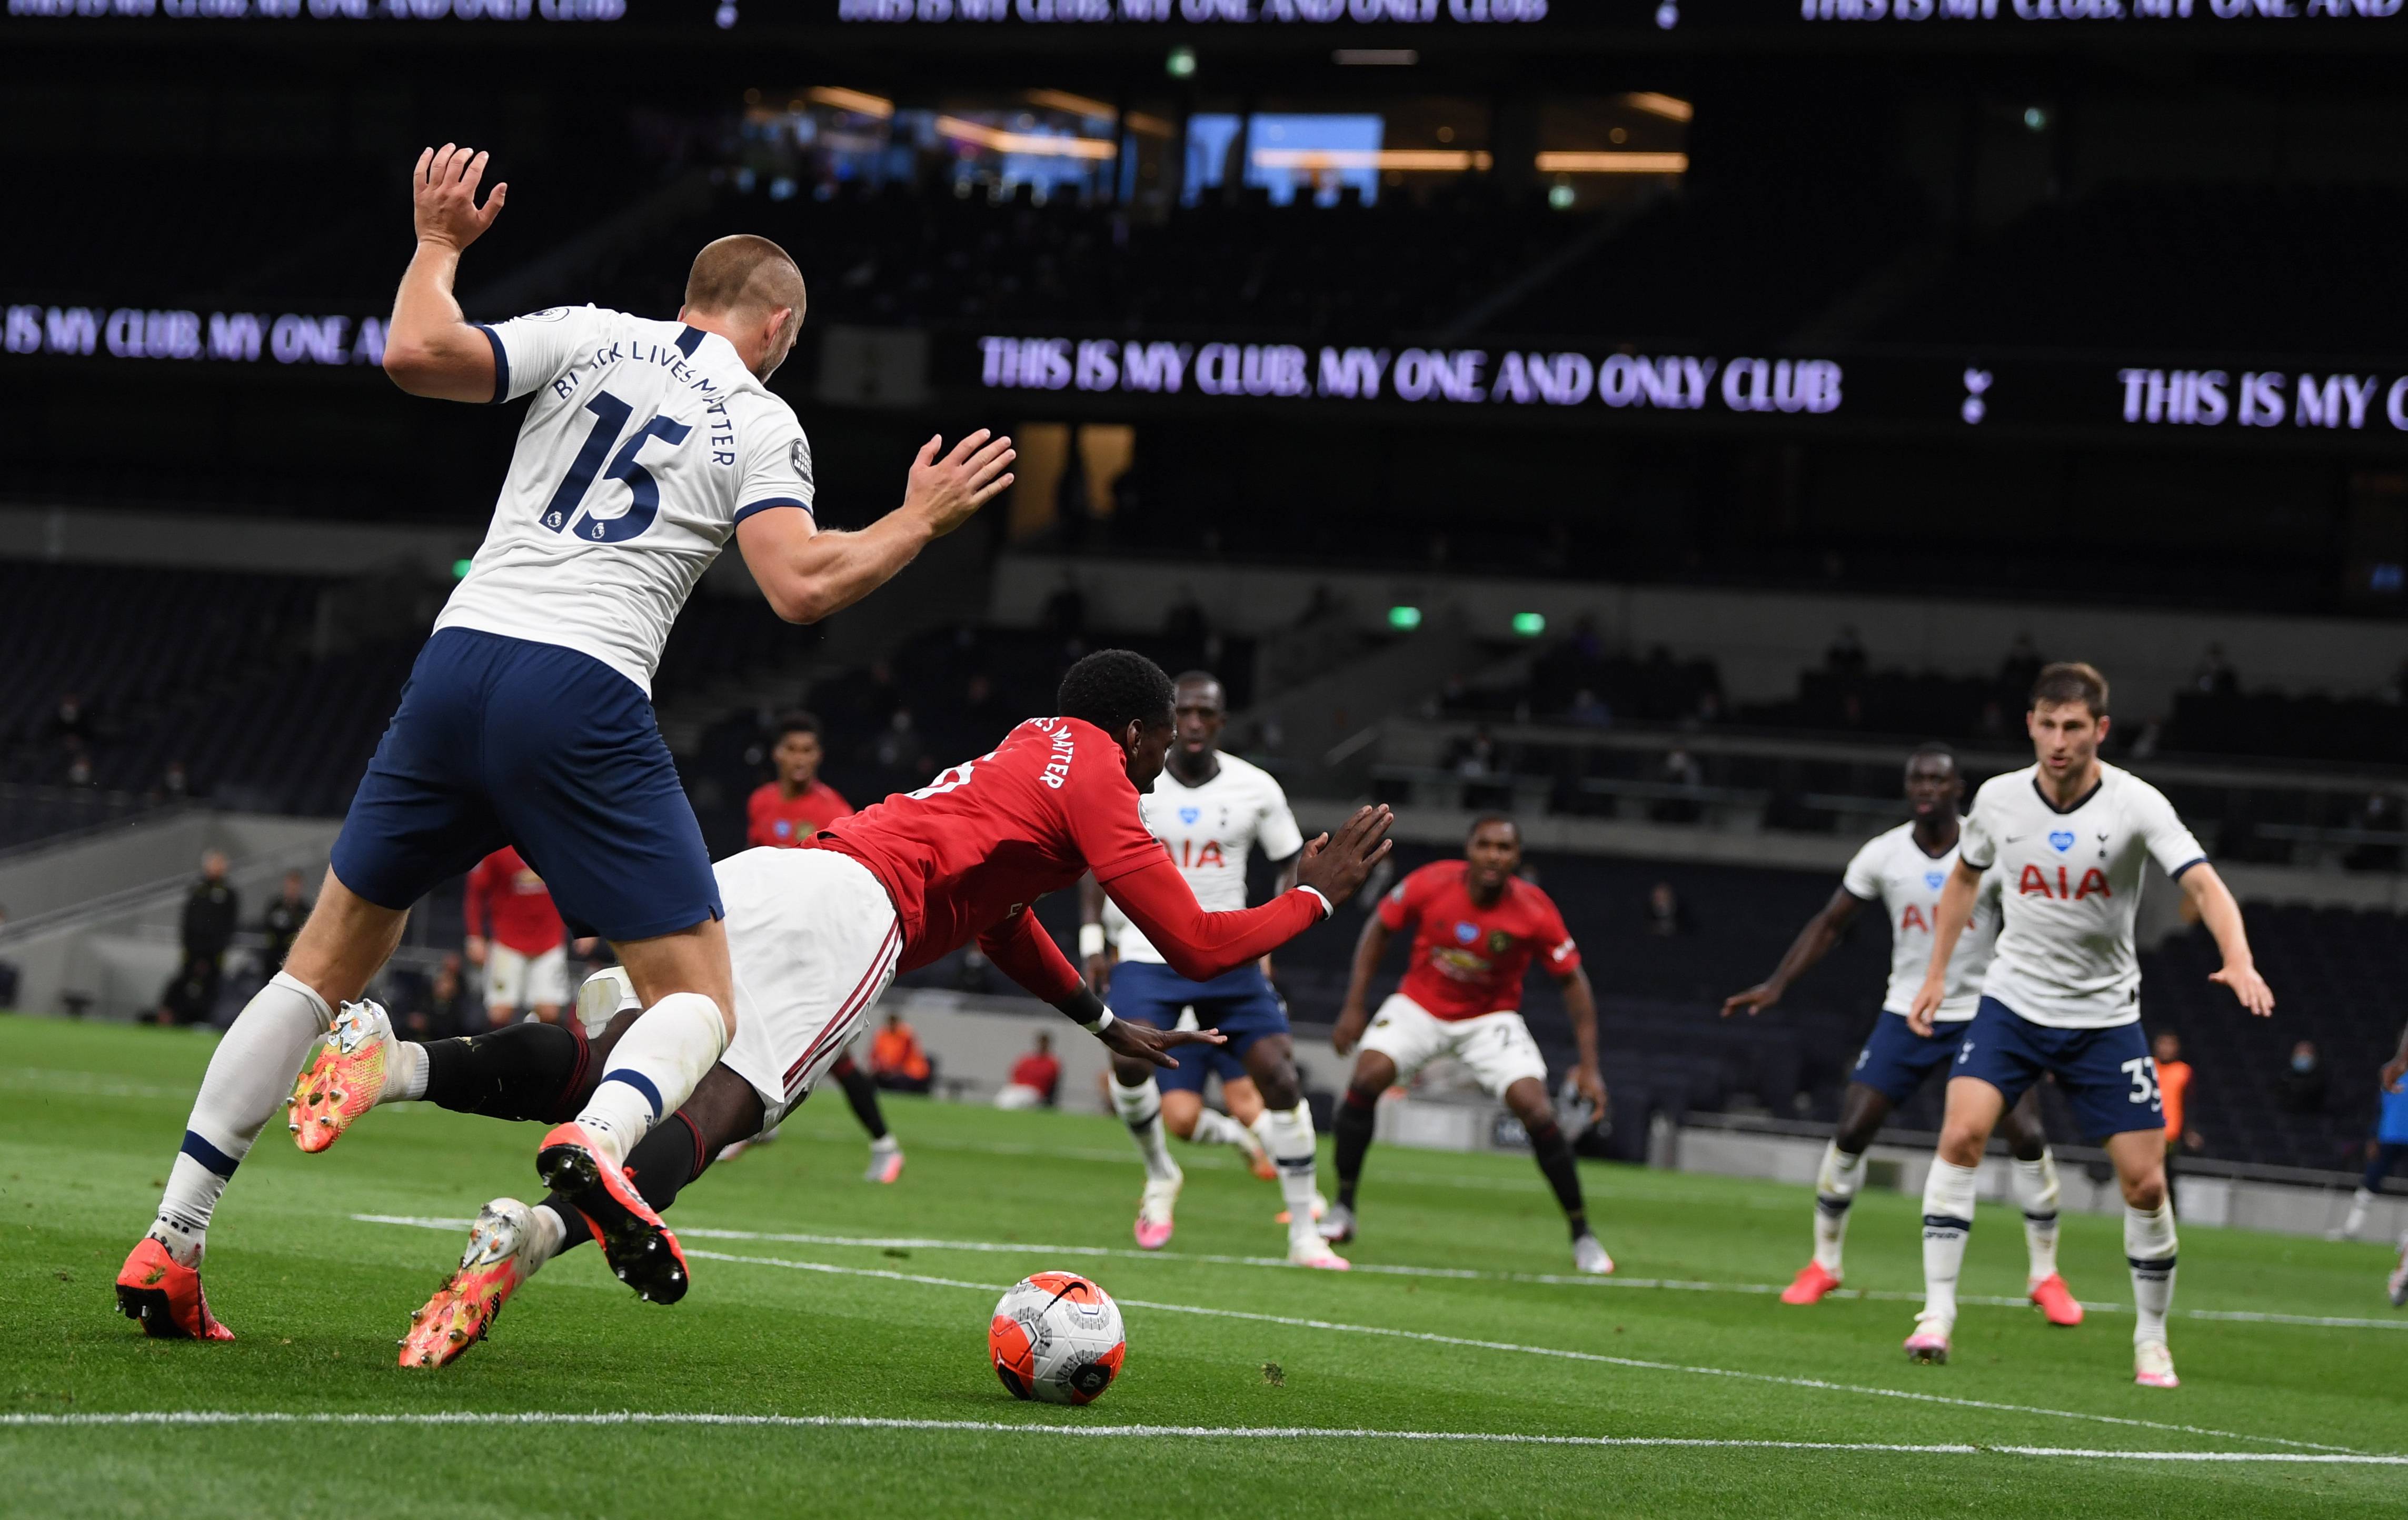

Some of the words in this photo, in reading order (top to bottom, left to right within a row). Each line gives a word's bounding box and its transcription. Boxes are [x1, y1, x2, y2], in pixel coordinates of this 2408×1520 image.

[5, 305, 42, 354] IS
[44, 306, 105, 356] MY
[207, 312, 270, 362] MY
[271, 314, 351, 365] ONE
[553, 342, 624, 400] BLCK
[632, 341, 697, 383] LIVES
[690, 377, 735, 466] MATTER
[977, 336, 1072, 391] THIS
[1076, 340, 1119, 392] IS
[1121, 341, 1192, 394] MY
[1317, 345, 1390, 400] MY
[1394, 347, 1487, 403] ONE
[1491, 350, 1594, 405] AND
[1598, 353, 1718, 409] ONLY
[1721, 356, 1843, 414] CLUB
[2117, 367, 2230, 426] THIS
[2237, 371, 2286, 427] IS
[2294, 373, 2379, 429] MY
[538, 389, 693, 543] 15
[1039, 724, 1074, 789] MATTER
[2019, 864, 2112, 901] AIA
